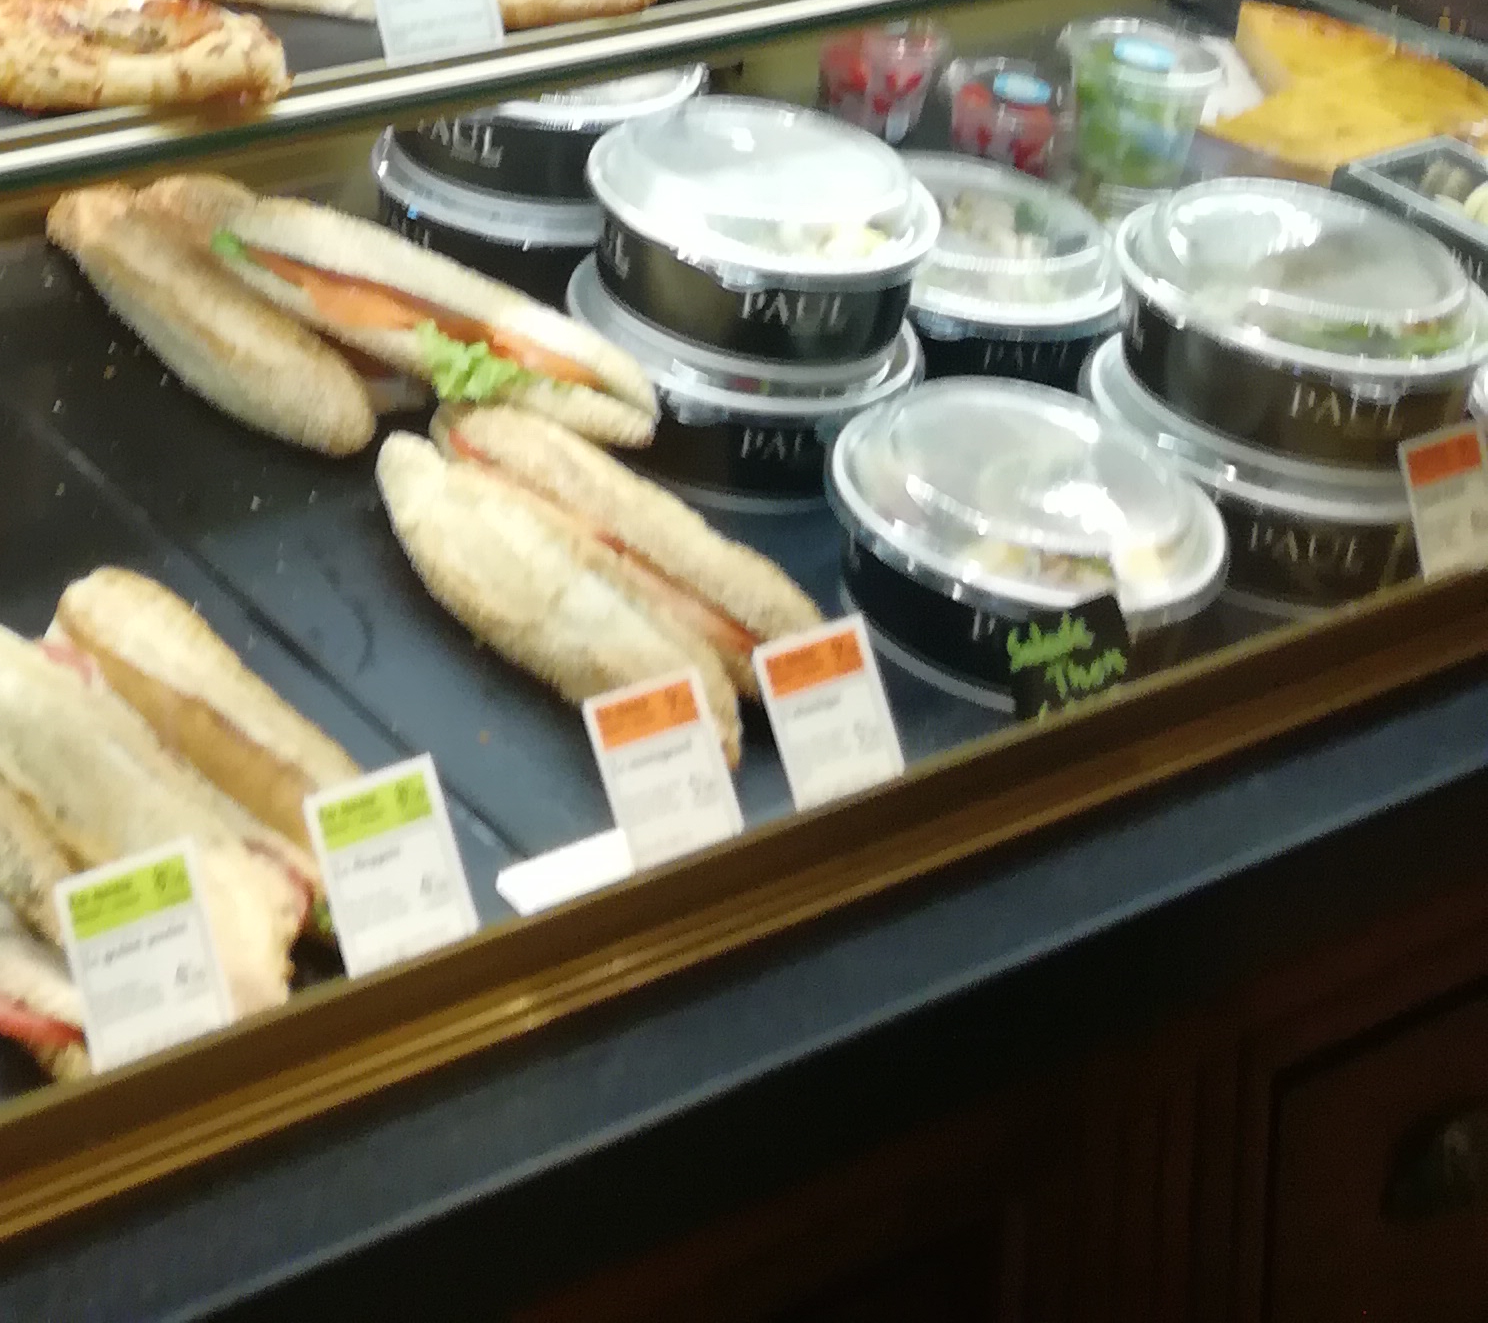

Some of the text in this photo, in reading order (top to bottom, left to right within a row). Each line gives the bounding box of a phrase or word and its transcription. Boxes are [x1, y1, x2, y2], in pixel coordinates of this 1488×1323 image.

[740, 289, 850, 336] PAUL
[1290, 383, 1404, 437] PAUL
[1249, 520, 1364, 575] PAUL
